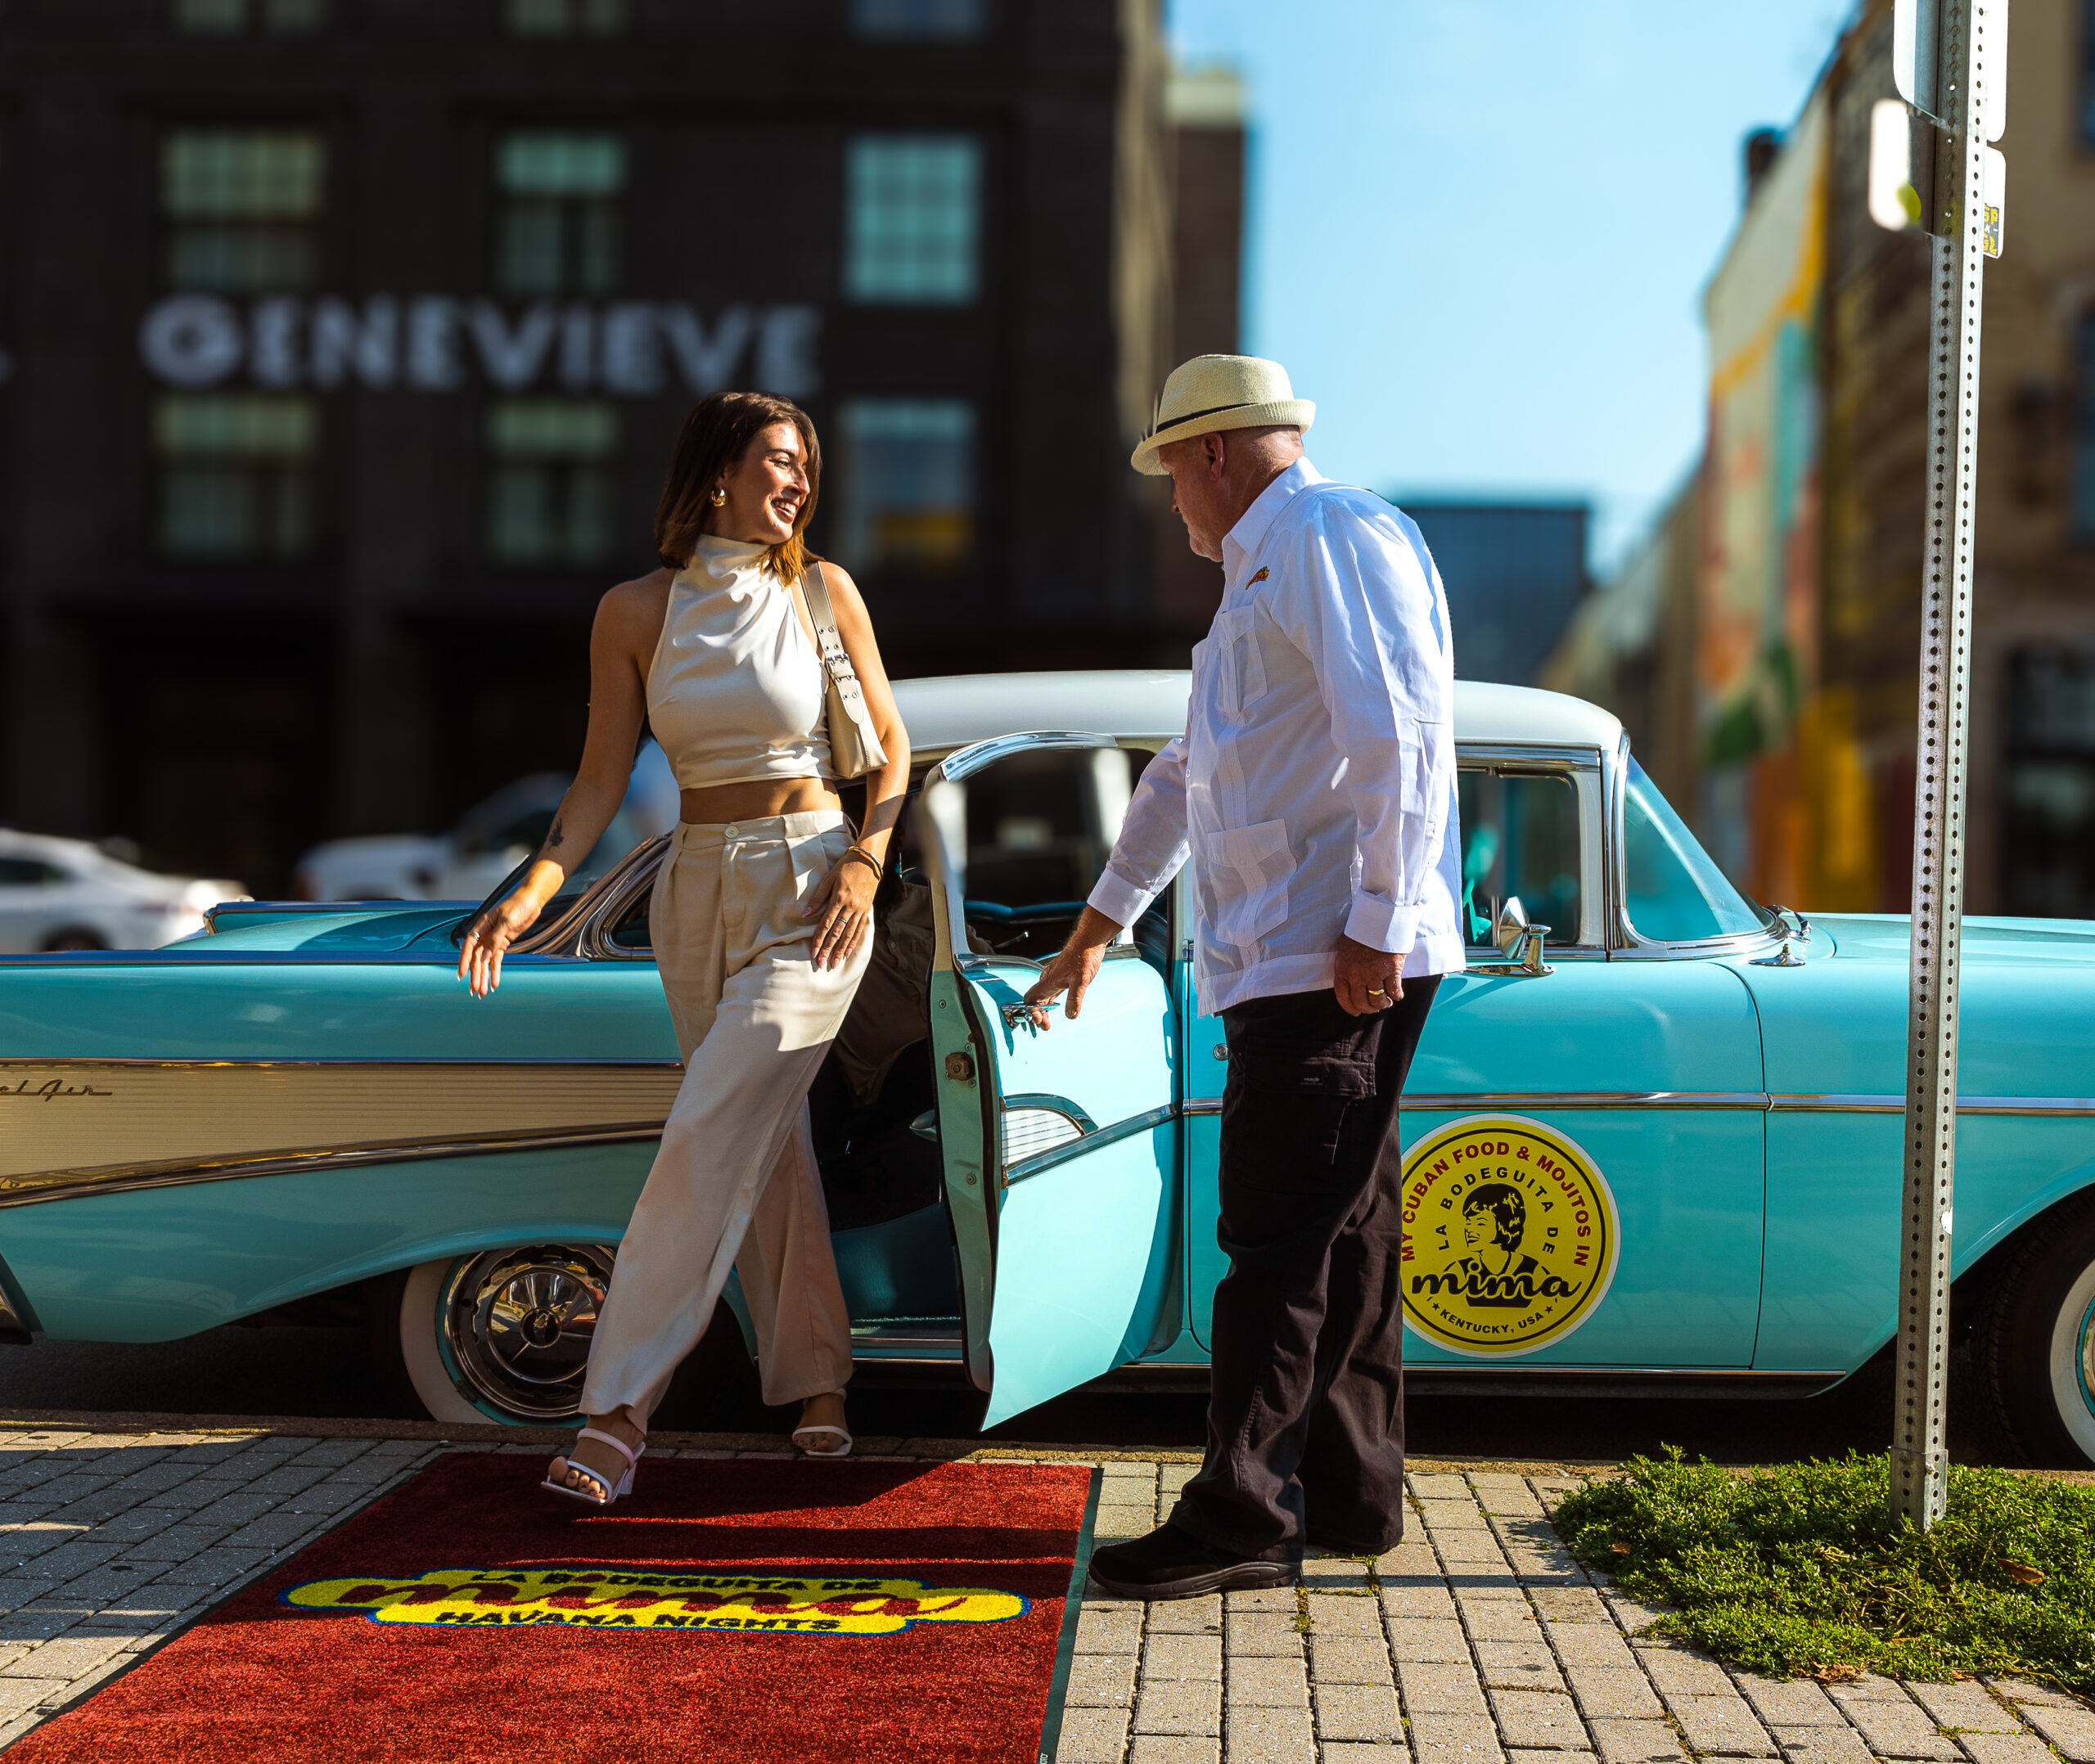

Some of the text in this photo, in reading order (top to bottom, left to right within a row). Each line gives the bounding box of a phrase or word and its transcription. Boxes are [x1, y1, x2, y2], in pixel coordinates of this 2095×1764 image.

[139, 295, 818, 396] GENEVIEVE
[0, 1079, 114, 1102] el Air
[1401, 1141, 1591, 1267] MY CUBAN FOOD & MOJITOS IN
[1435, 1166, 1559, 1254] LA BODEGUITA DE
[1411, 1267, 1583, 1299] mima
[1439, 1309, 1545, 1334] KENTUCKY, USA
[471, 1573, 882, 1591] LA BODEGUITA DE
[336, 1579, 968, 1618] mima
[435, 1610, 841, 1631] HAVANA NIGHTS
